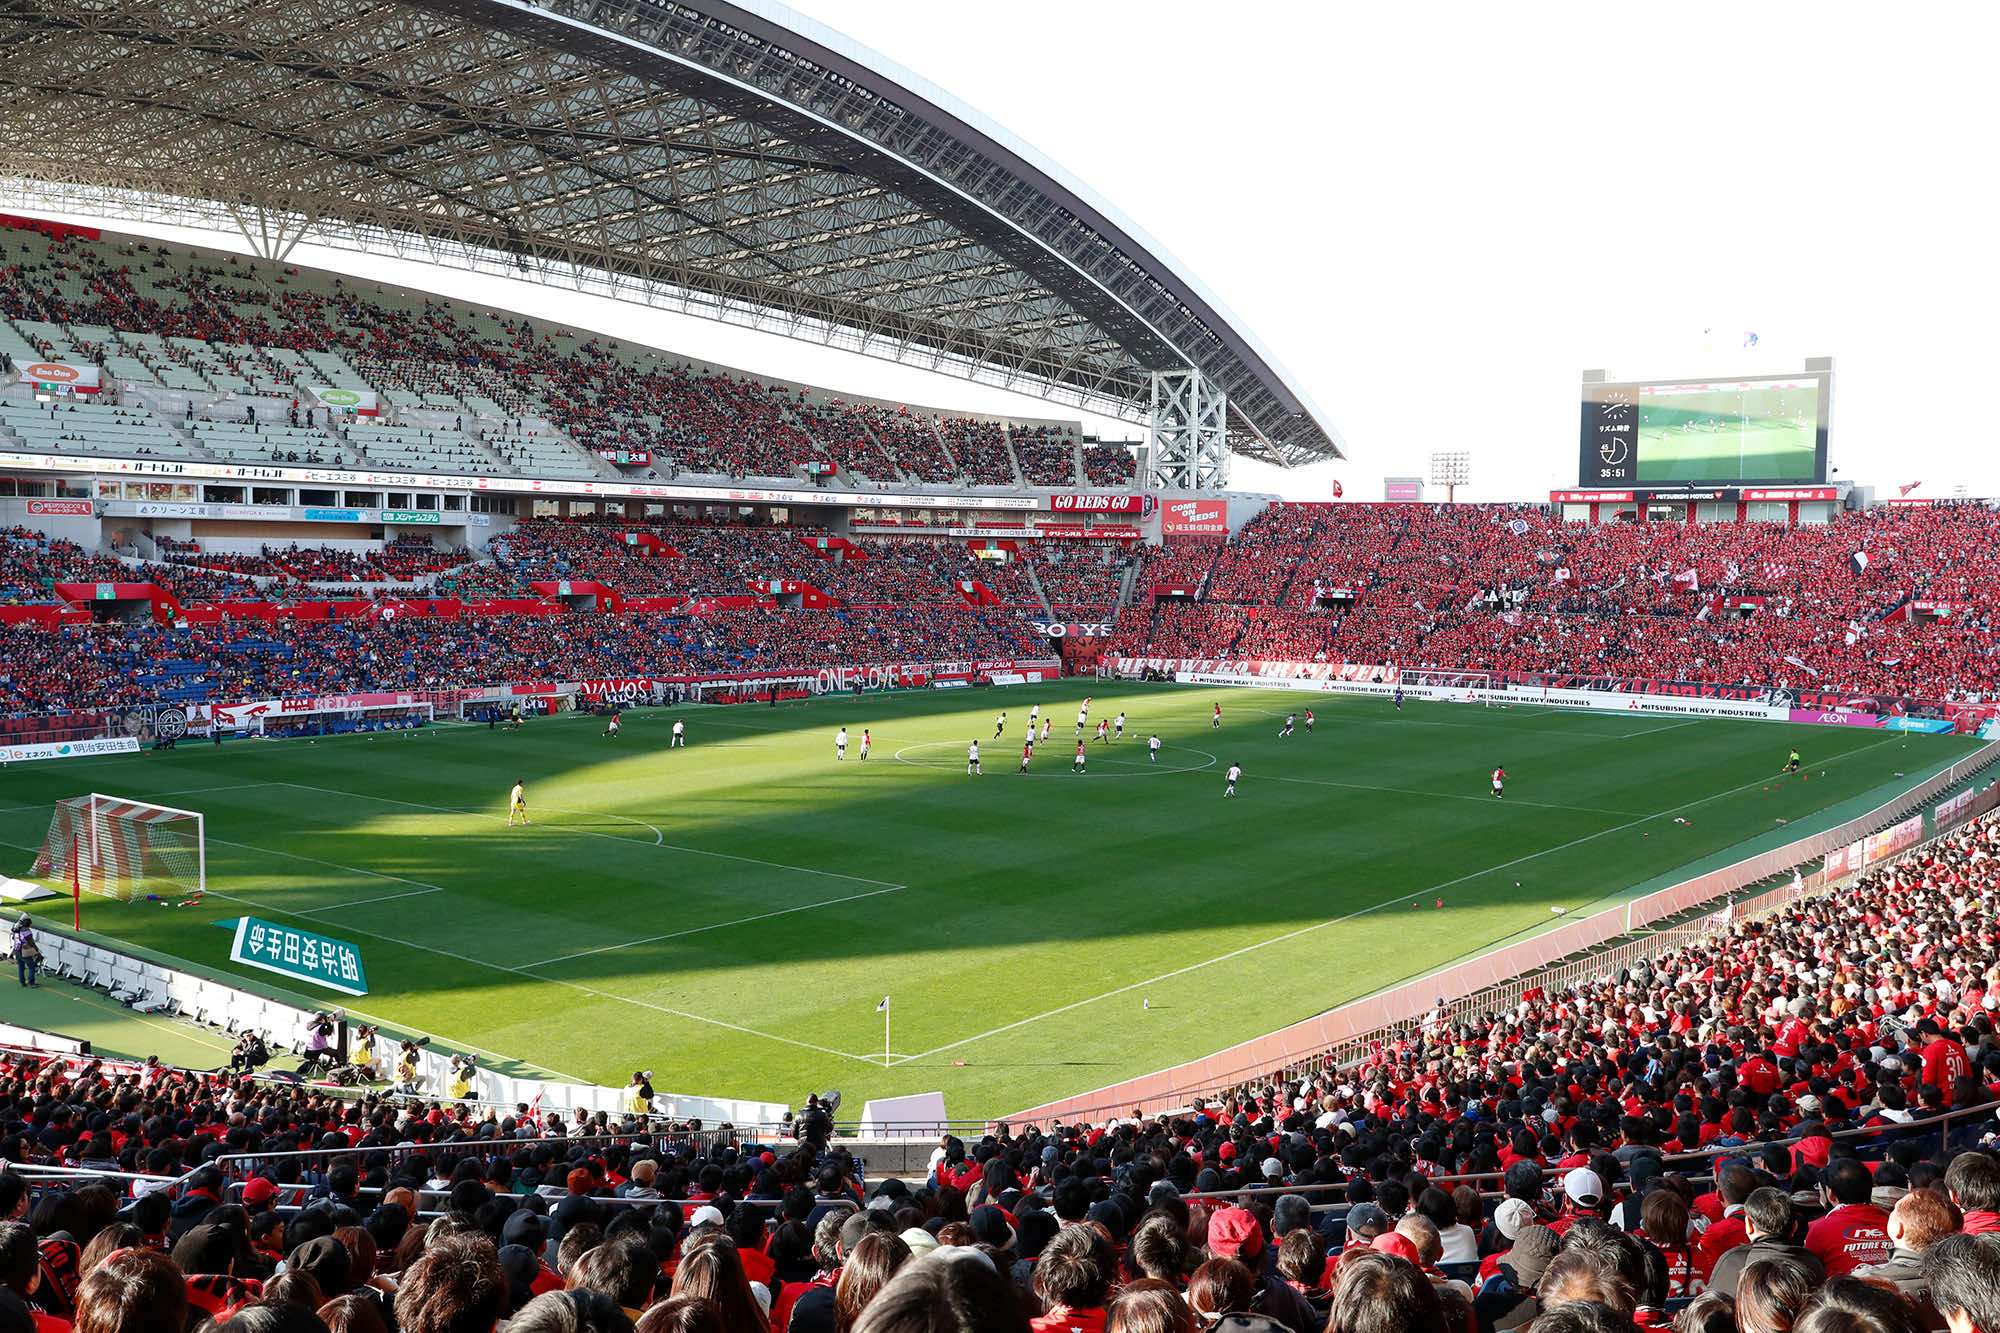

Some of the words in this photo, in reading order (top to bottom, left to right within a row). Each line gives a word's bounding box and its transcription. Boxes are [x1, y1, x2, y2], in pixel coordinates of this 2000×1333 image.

[1601, 469, 1625, 477] 35:51
[1055, 496, 1073, 509] GO
[1074, 496, 1110, 509] REDS
[1111, 496, 1130, 509] GO
[1171, 503, 1197, 512] COME
[1182, 509, 1196, 517] ON
[1189, 512, 1219, 522] REDS!
[818, 667, 853, 692] ONE
[859, 665, 898, 689] LOVE
[1199, 677, 1233, 685] MITSUBISHI
[1331, 685, 1369, 693] MITSUBISHI
[1392, 689, 1433, 697] IDUSTRIES
[1546, 698, 1591, 706] INDUSTRIES
[1641, 704, 1687, 712] MITSUBISHI
[1718, 709, 1768, 718] INDUSTRIES
[73, 741, 138, 752] 明治安田生命
[248, 924, 360, 982] 明治安田生命
[1843, 1242, 1880, 1253] FUTURE
